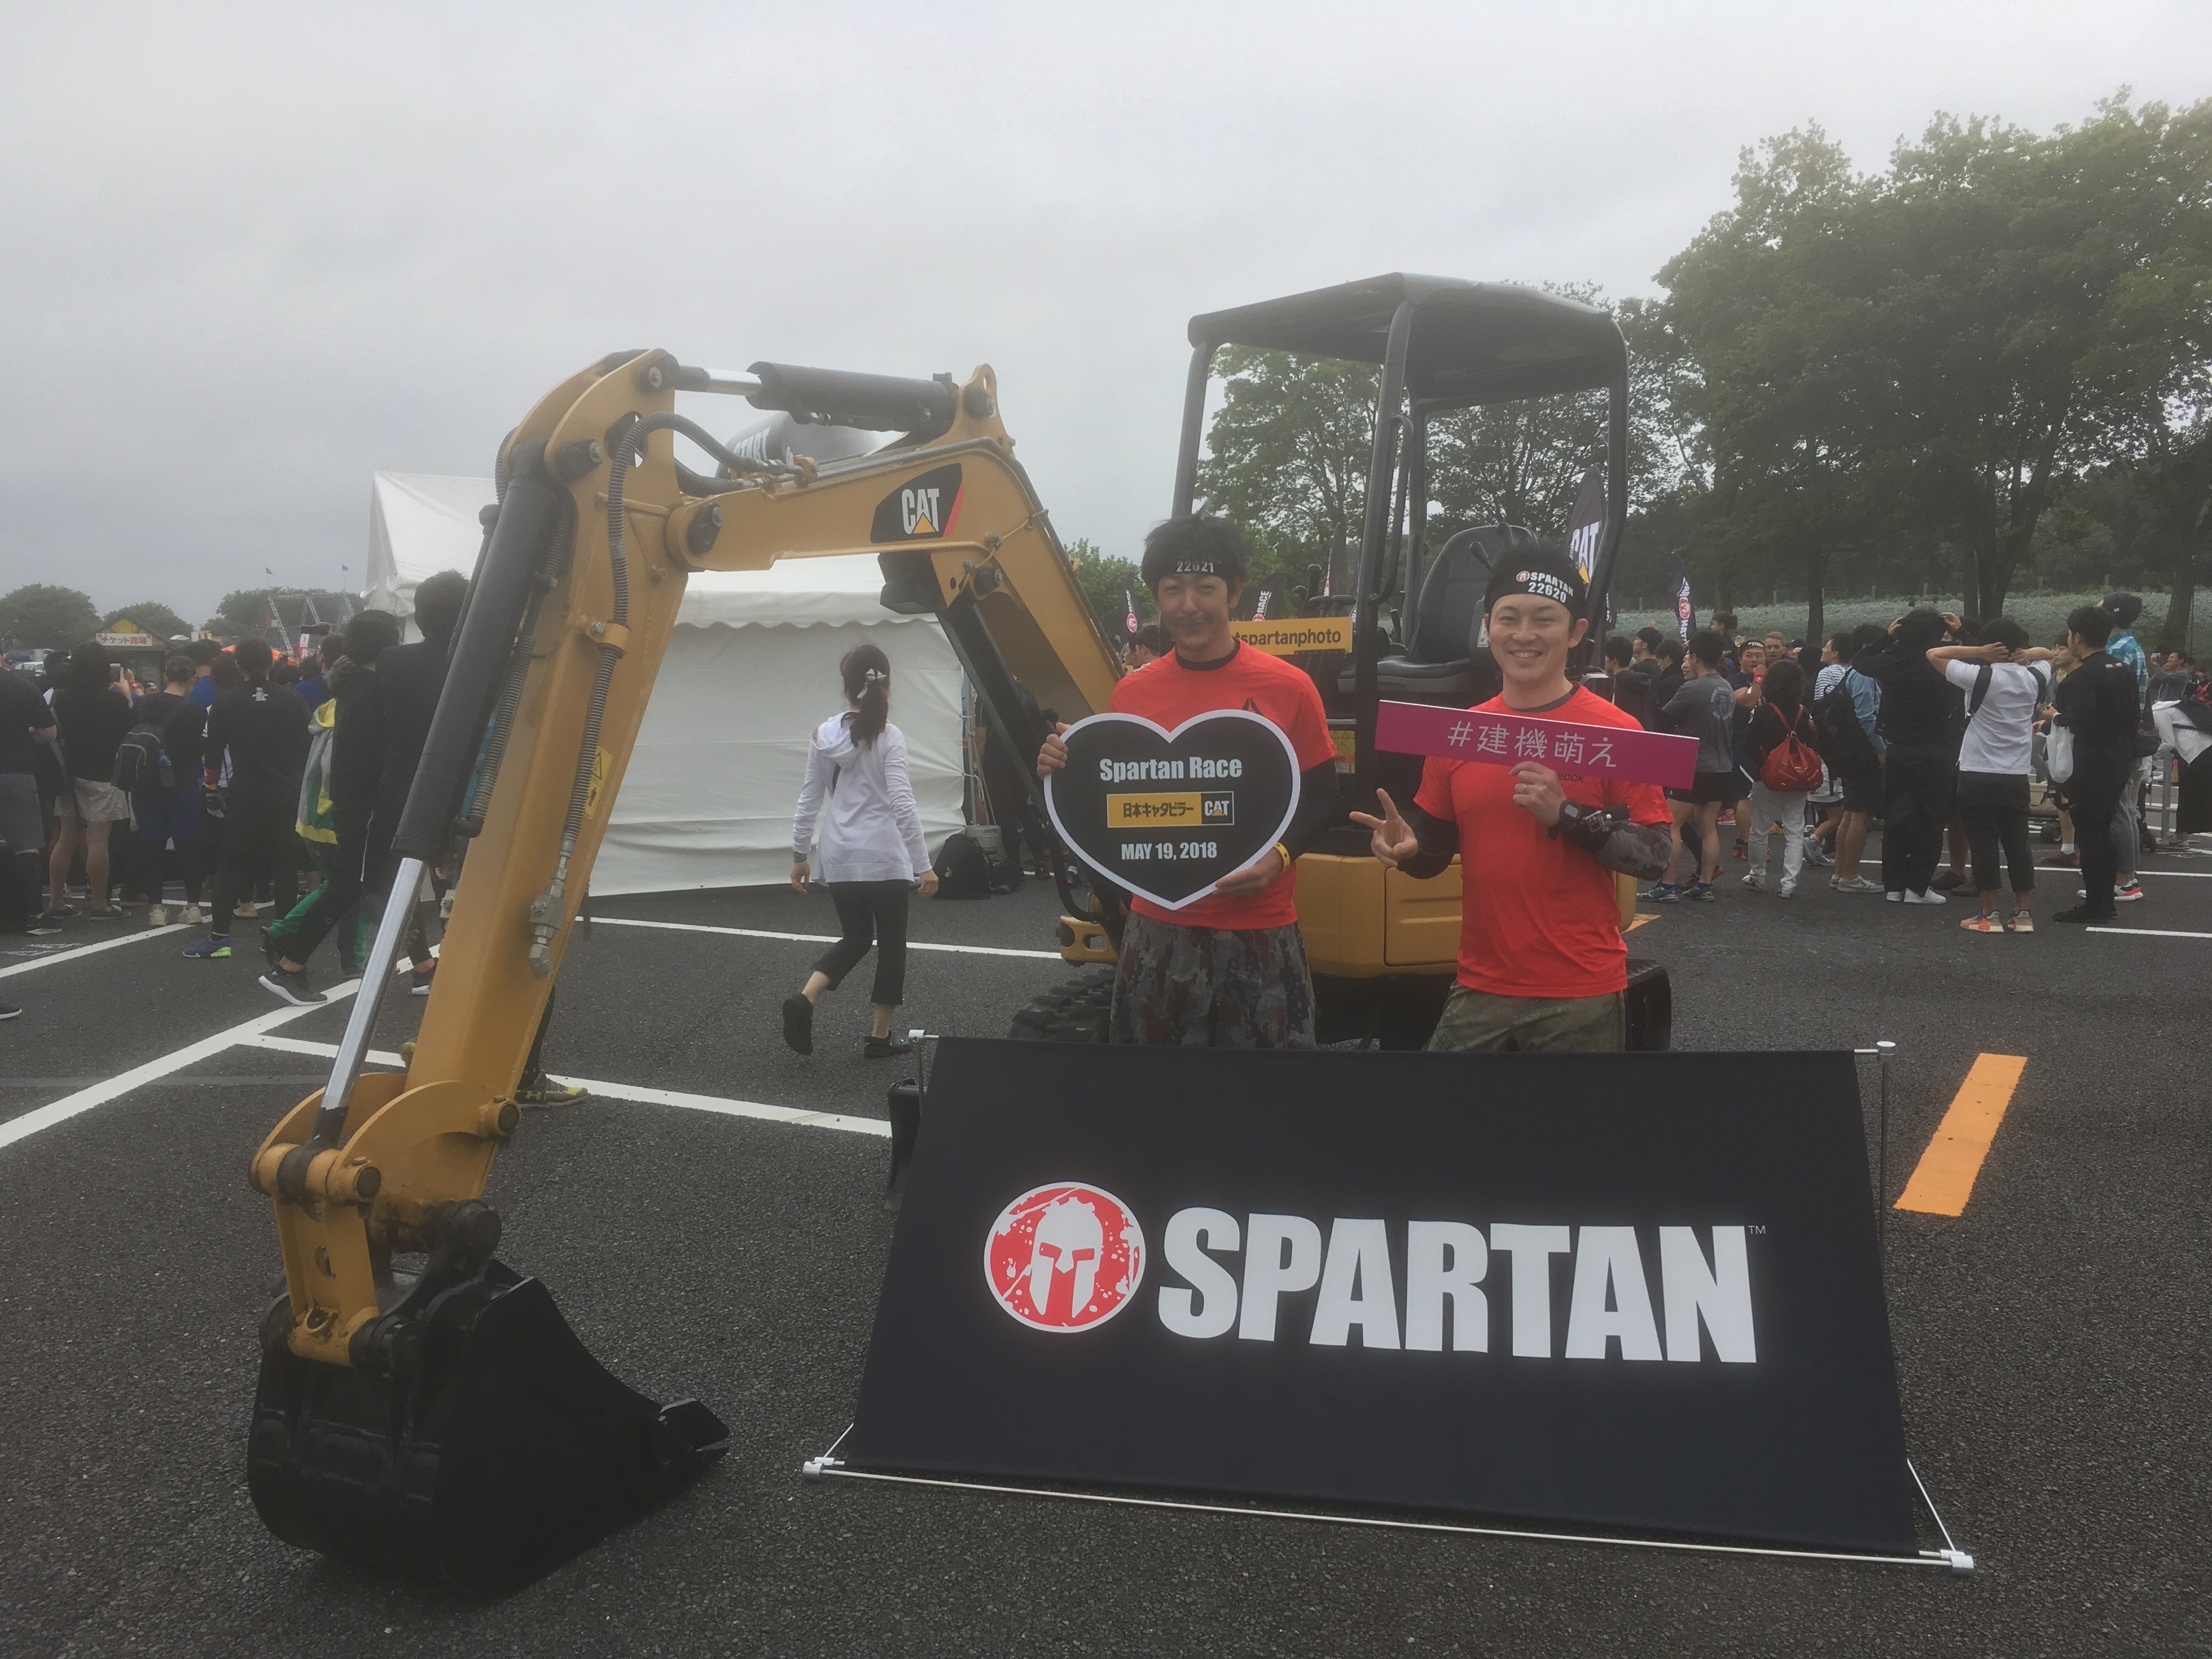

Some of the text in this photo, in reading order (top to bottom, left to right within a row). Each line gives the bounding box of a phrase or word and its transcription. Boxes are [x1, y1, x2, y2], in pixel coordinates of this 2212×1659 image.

[902, 488, 940, 534] CAT
[1528, 582, 1567, 603] 22620
[1530, 572, 1573, 597] SPARTAN
[1257, 590, 1269, 613] RACE
[1235, 628, 1341, 647] tspartanphoto
[1447, 720, 1617, 768] #建機萌え
[1099, 756, 1243, 783] Spartan Race
[1123, 802, 1194, 818] 日本キャタピラー
[1204, 800, 1230, 816] CAT
[1121, 841, 1218, 861] MAY 19, 2018
[1158, 1207, 1756, 1363] SPARTAN
